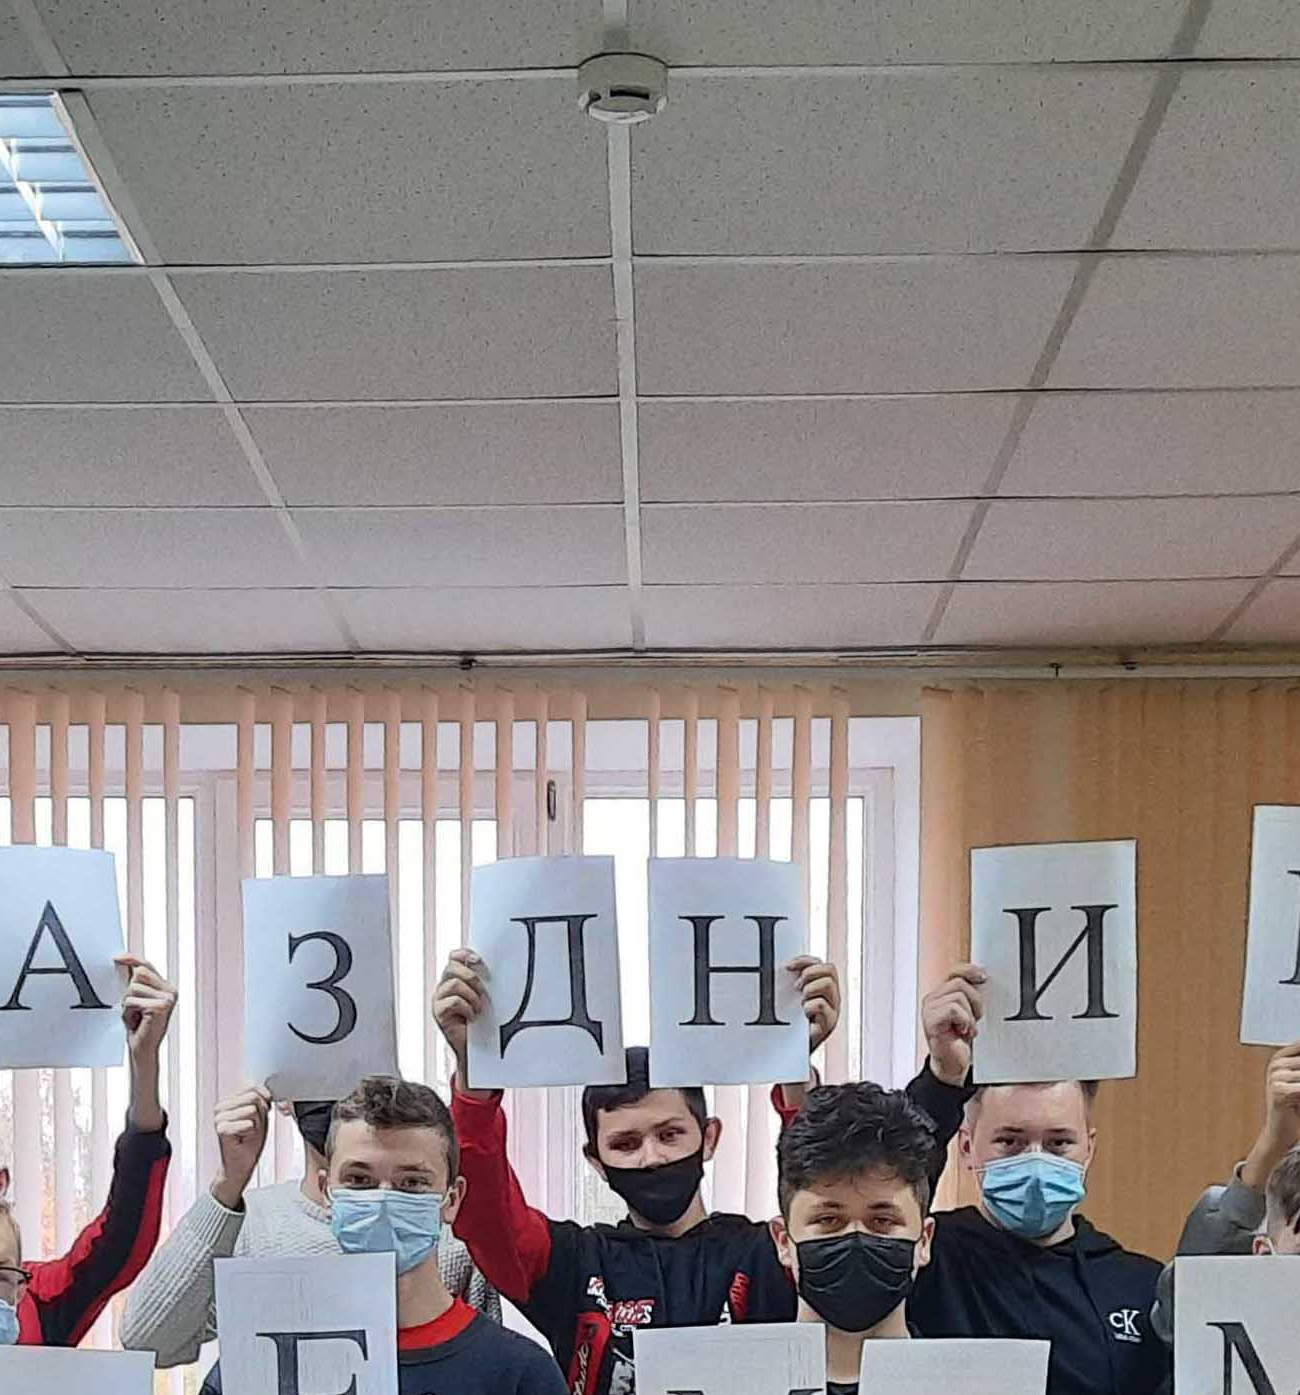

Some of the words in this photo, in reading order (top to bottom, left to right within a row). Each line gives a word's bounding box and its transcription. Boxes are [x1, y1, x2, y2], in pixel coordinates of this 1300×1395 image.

[288, 931, 357, 1044] З
[499, 914, 604, 1059] Д
[678, 916, 790, 1026] Н
[1003, 904, 1119, 1021] И
